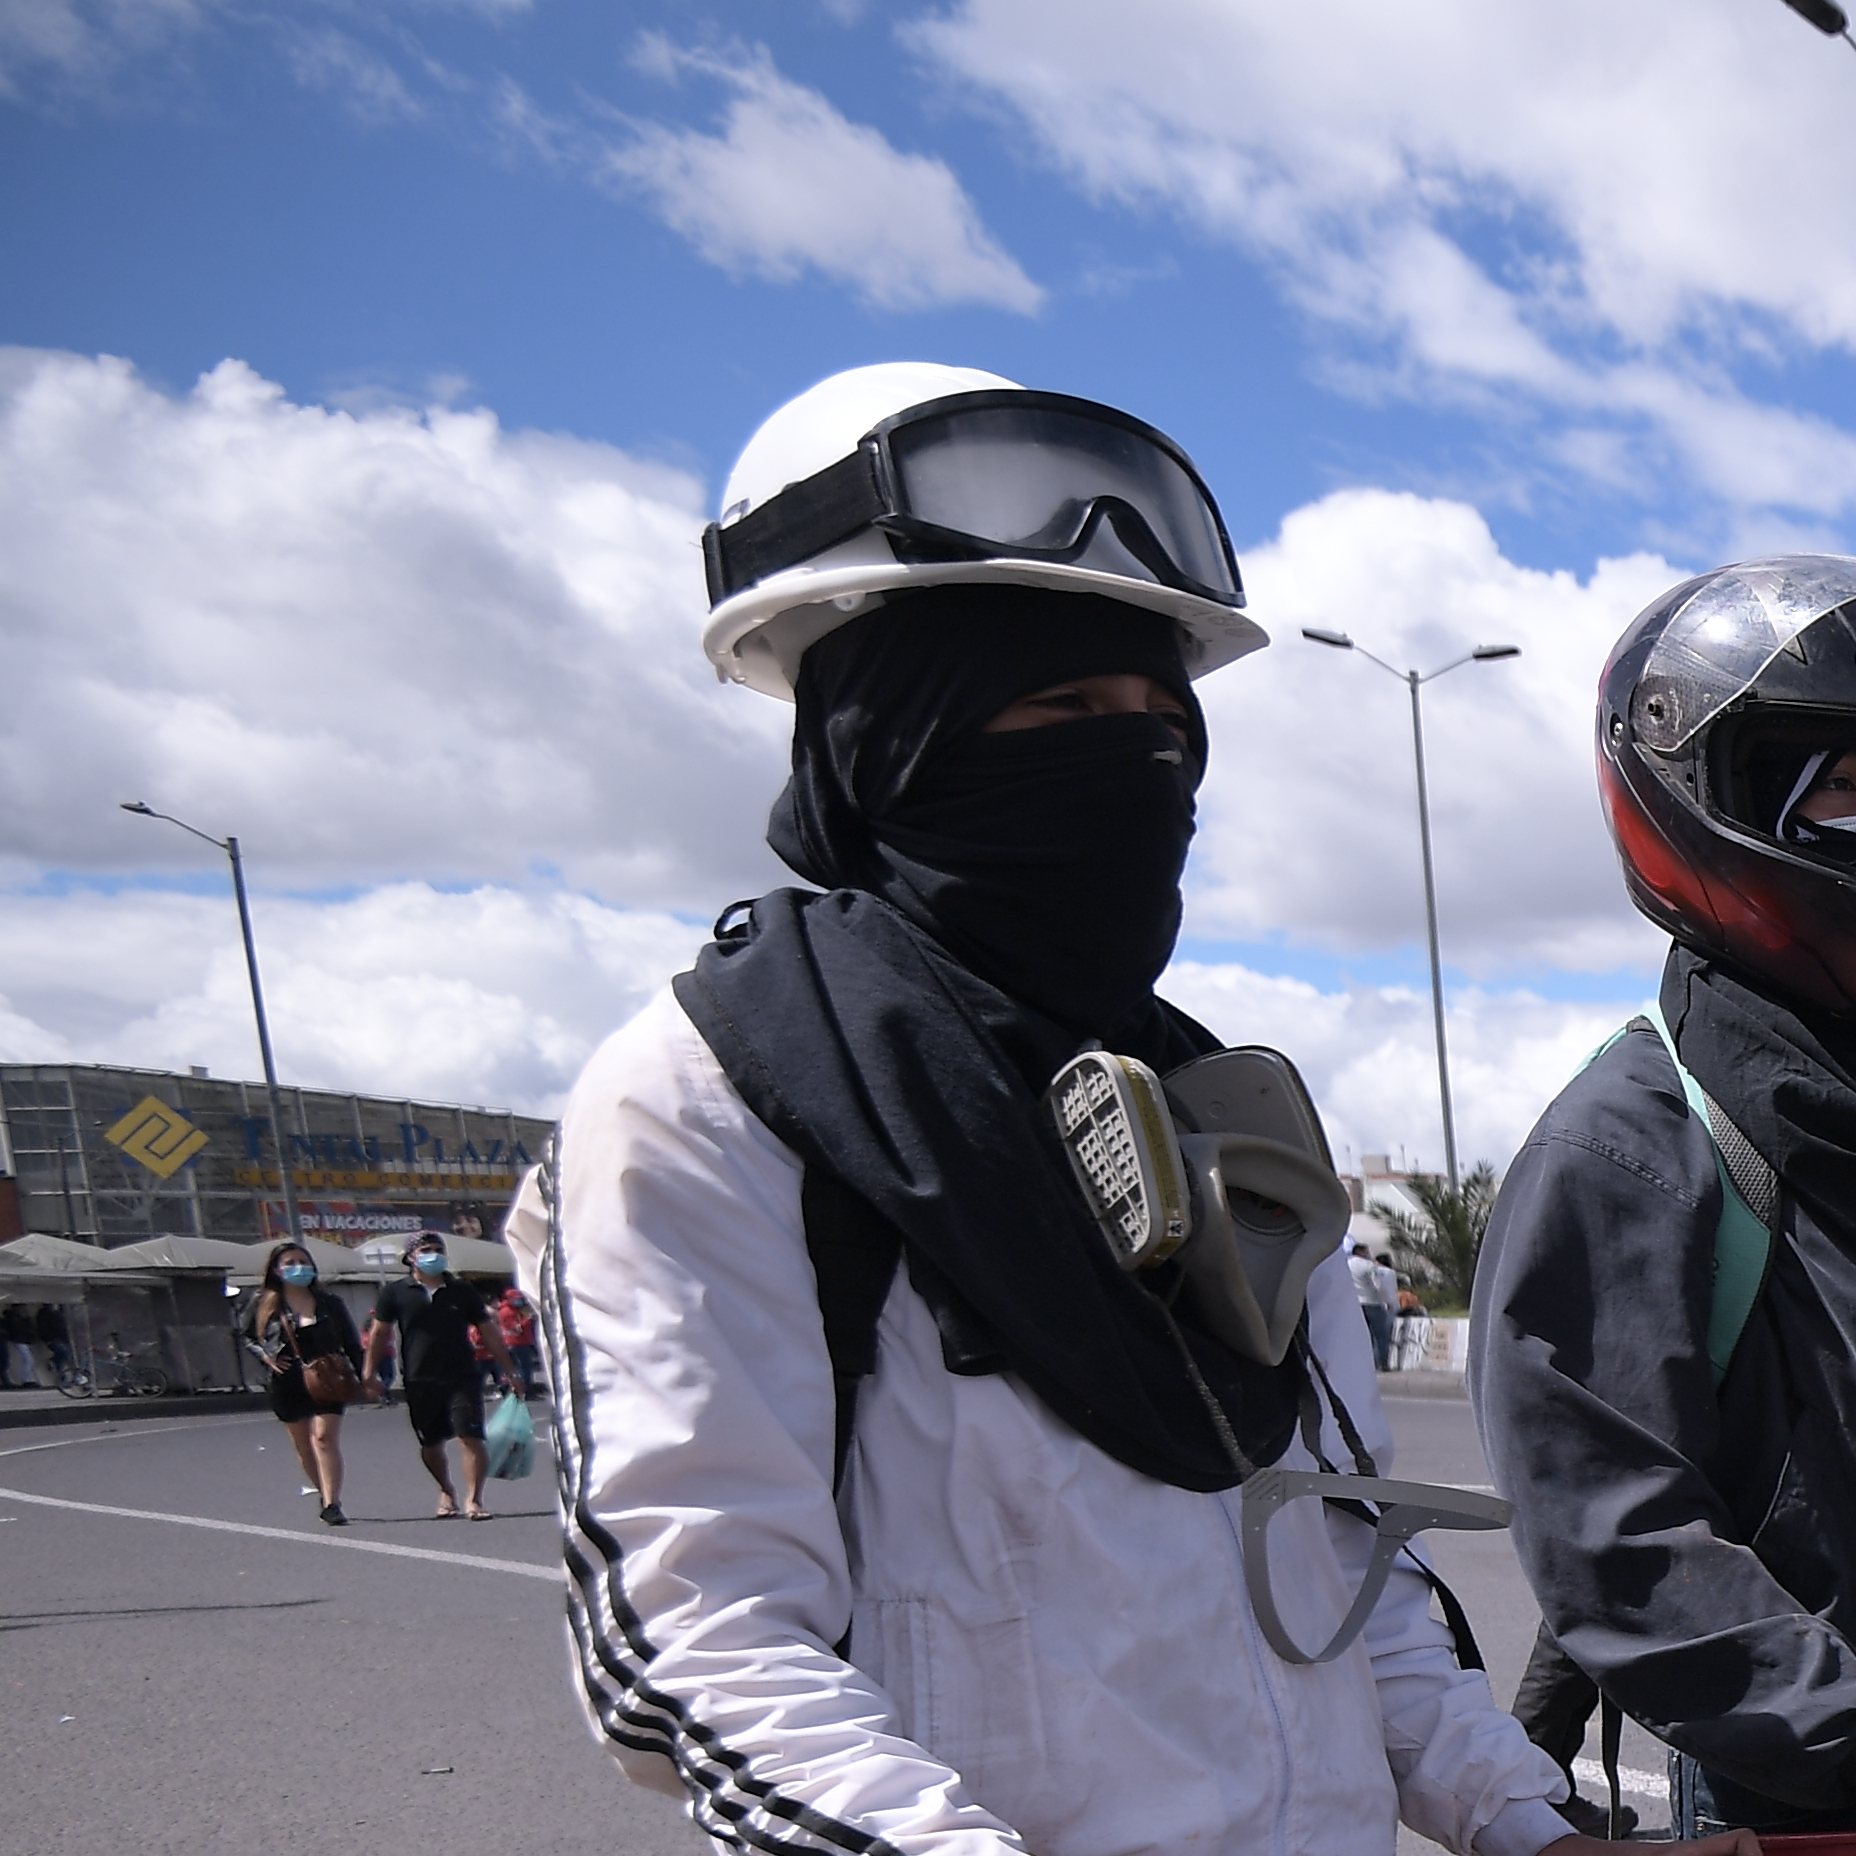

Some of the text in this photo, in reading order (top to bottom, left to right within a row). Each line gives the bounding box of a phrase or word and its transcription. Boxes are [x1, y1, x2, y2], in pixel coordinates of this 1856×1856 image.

[230, 1115, 533, 1165] TNTAL PLAZA
[237, 1171, 358, 1186] CETRO
